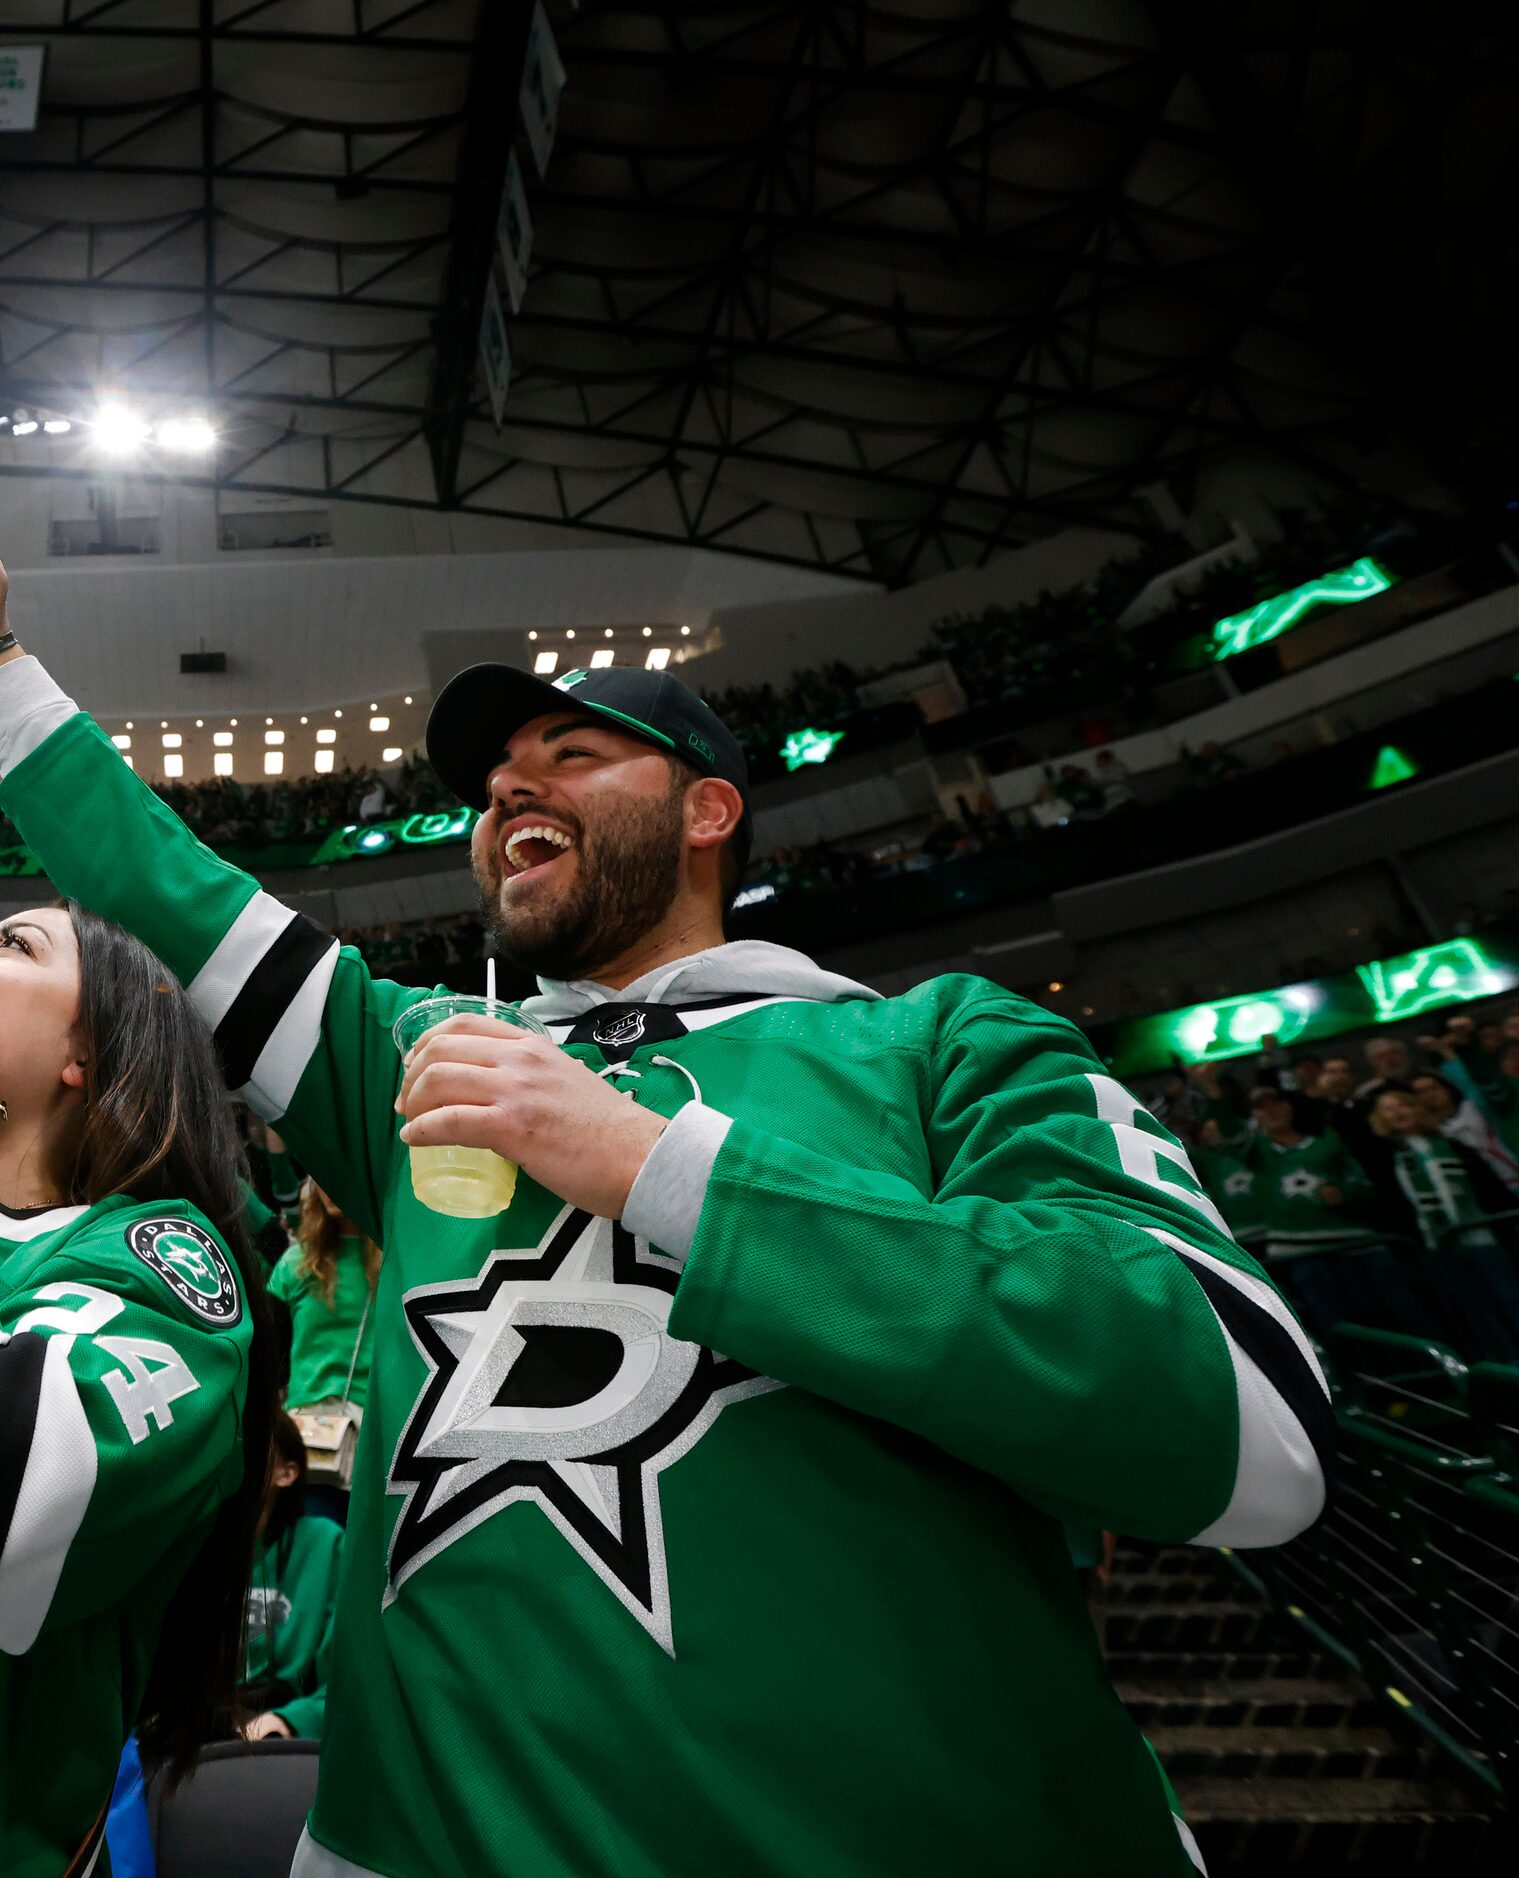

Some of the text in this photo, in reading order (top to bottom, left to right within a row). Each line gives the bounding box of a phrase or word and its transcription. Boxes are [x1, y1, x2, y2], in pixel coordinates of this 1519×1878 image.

[605, 1018, 635, 1037] NHL
[141, 1249, 226, 1316] STARS
[144, 1222, 234, 1297] DALLAS
[13, 1281, 201, 1446] 24
